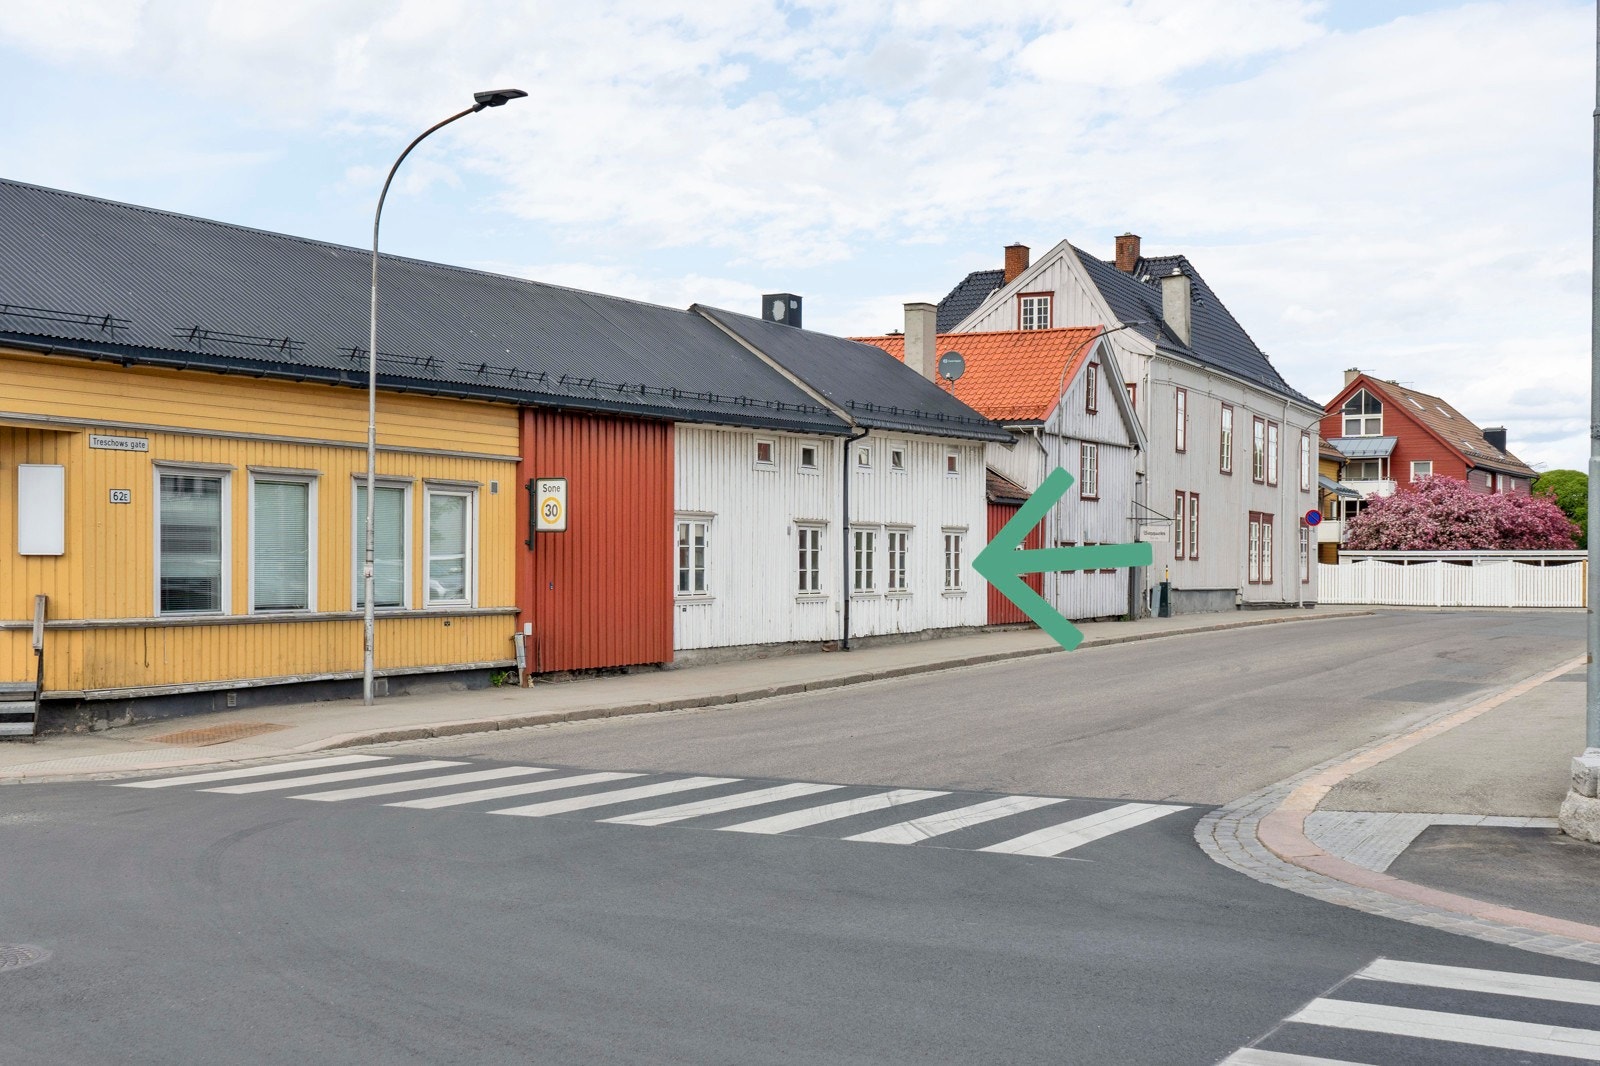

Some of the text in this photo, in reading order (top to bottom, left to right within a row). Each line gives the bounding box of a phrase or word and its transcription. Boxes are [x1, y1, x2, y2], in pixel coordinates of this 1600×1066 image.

[93, 437, 146, 449] Treschows gate
[542, 483, 561, 493] Sone
[113, 491, 128, 501] 62E
[545, 503, 559, 517] 30
